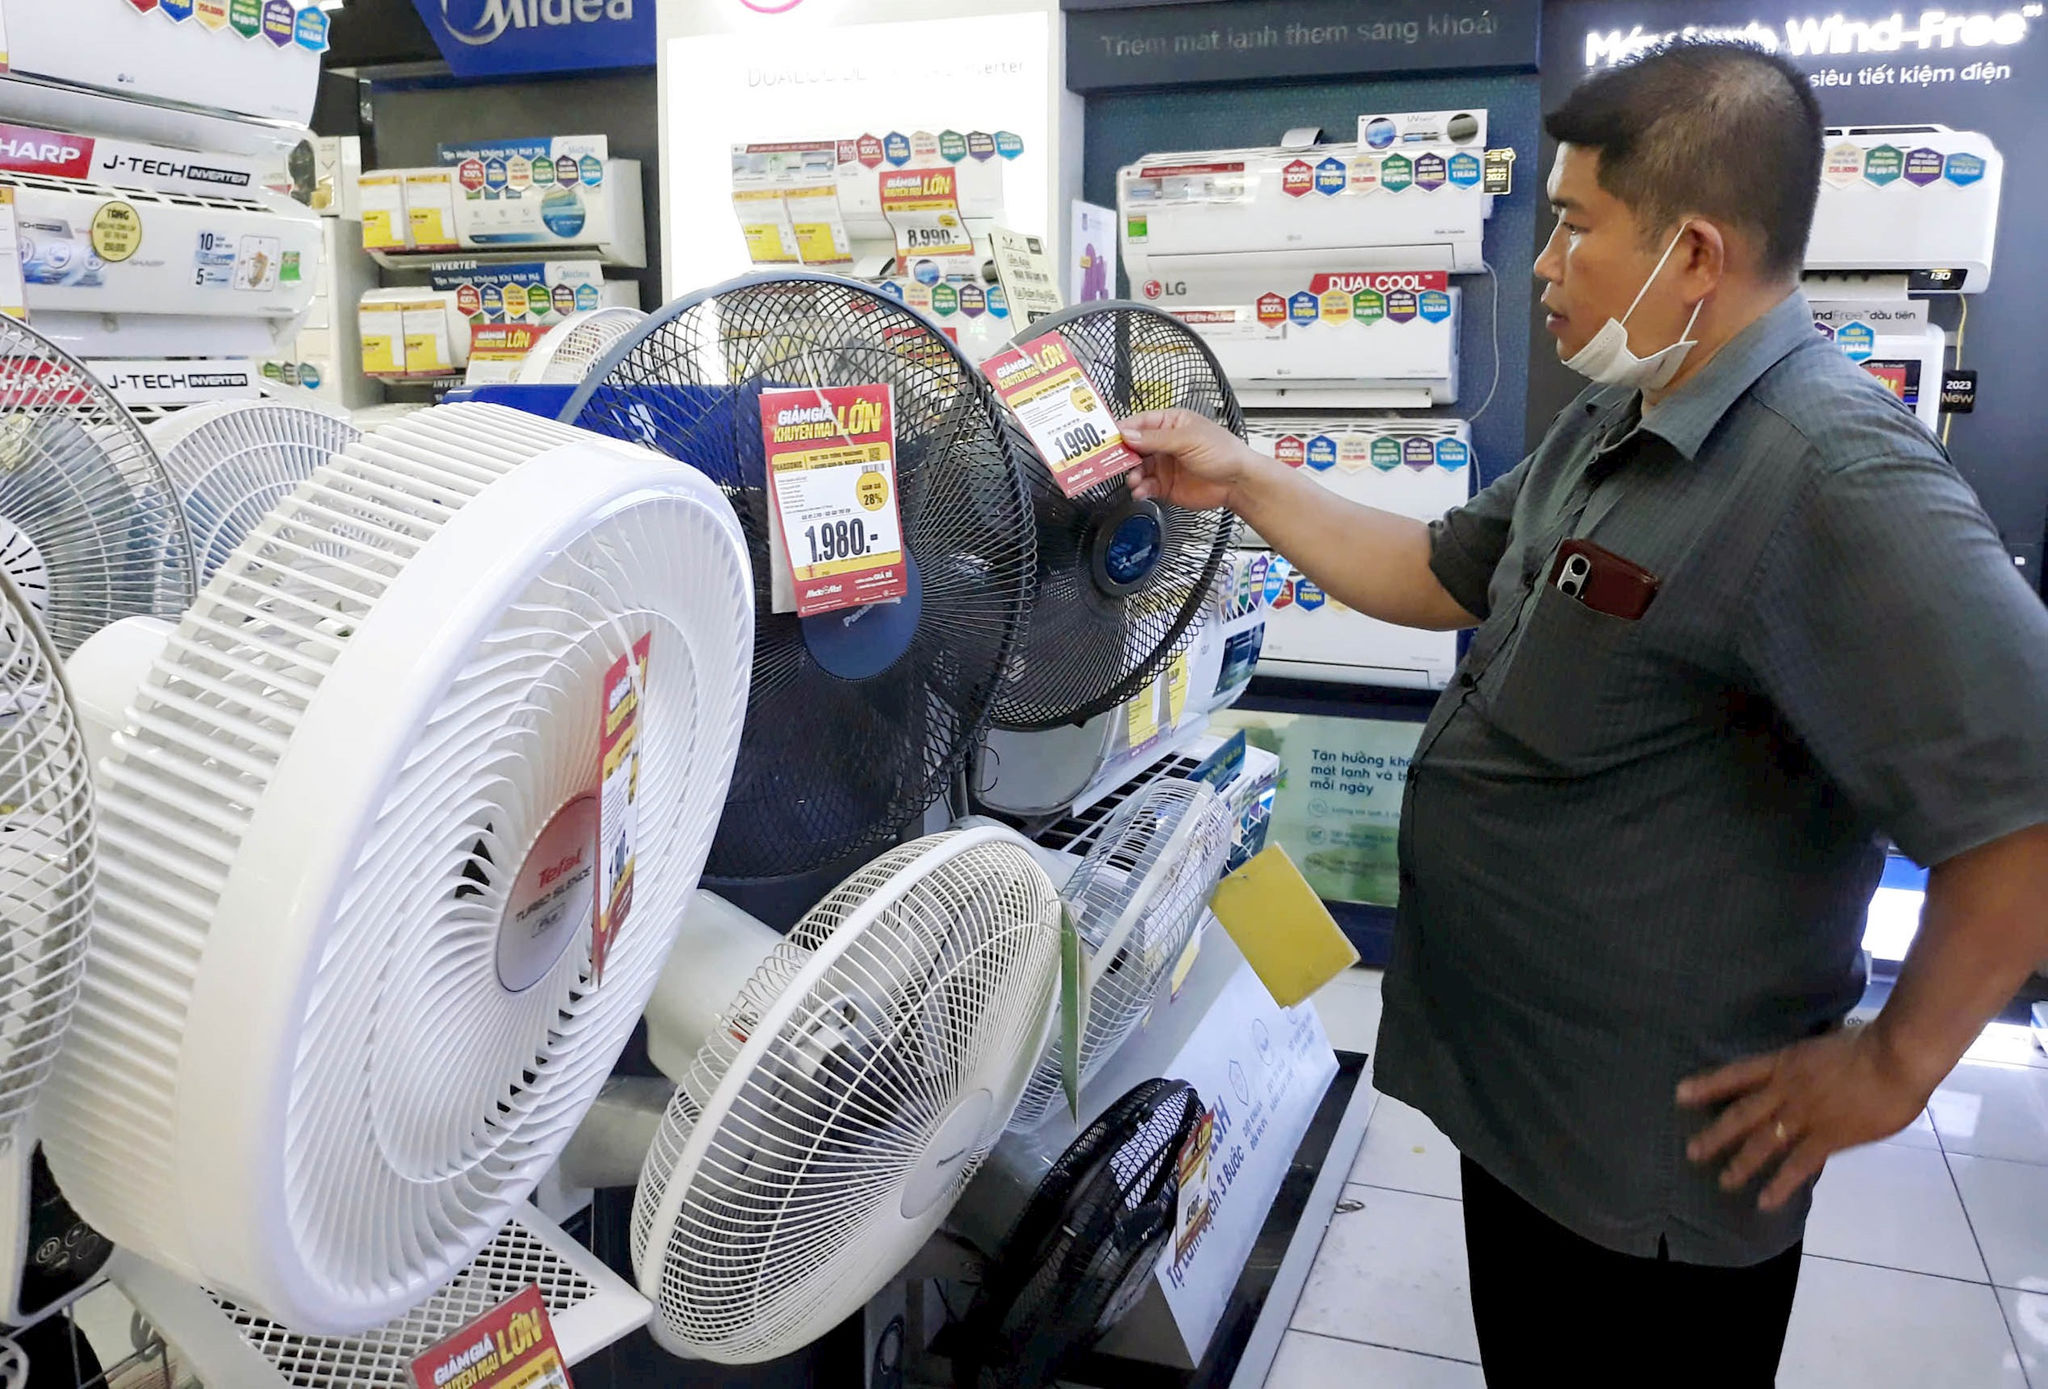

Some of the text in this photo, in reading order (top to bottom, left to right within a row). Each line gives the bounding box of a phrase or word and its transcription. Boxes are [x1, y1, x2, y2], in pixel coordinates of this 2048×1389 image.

[1809, 61, 2010, 88] siêu tiết kiệm điện
[103, 153, 248, 186] J-TECH INVERTER
[200, 232, 214, 251] 10
[432, 260, 478, 272] INVERTER
[196, 268, 204, 286] 5
[1165, 281, 1187, 296] LG
[107, 374, 247, 390] J-TECH INVERTER
[1946, 380, 1972, 390] 2023
[1941, 392, 1974, 404] New
[777, 403, 813, 426] GIẢM
[836, 397, 882, 436] LỚN
[863, 493, 883, 506] 28%
[1339, 781, 1375, 797] ngày
[538, 847, 582, 889] Tefal
[1216, 1174, 1227, 1197] 3
[1222, 1144, 1246, 1187] Bước
[496, 1306, 543, 1367] LỚN
[433, 1331, 496, 1386] GIẢM GIÁ
